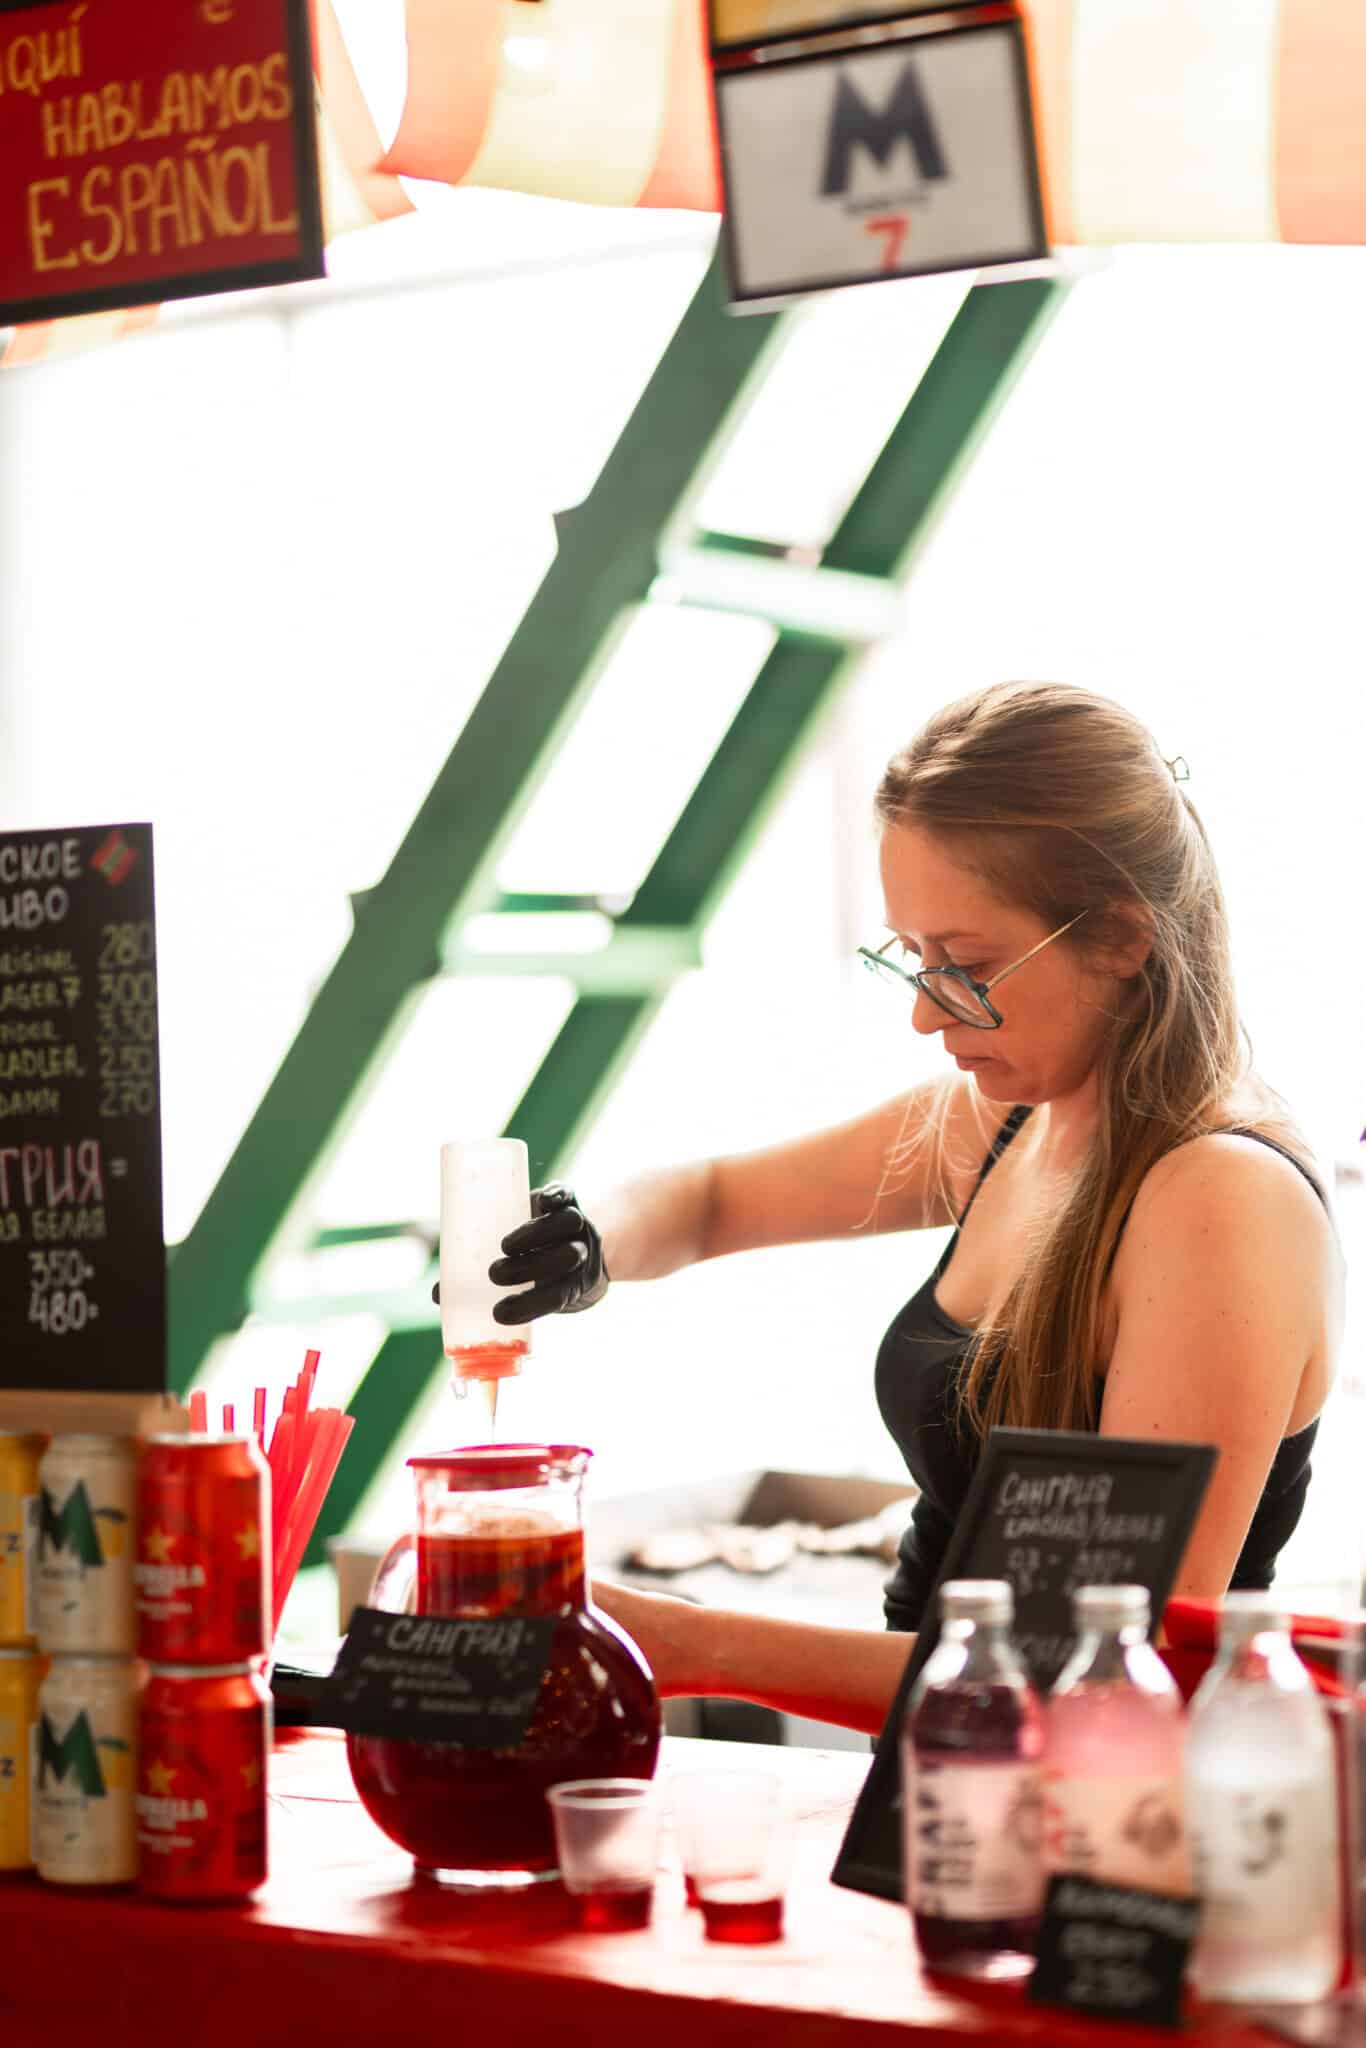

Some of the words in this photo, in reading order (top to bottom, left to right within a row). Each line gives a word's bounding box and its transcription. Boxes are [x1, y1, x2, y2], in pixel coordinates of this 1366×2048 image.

[0, 3, 88, 96] QUÍ
[42, 52, 292, 158] HABLAMOS
[819, 52, 949, 197] M
[28, 135, 297, 272] ESPAÑOL
[866, 214, 909, 273] 7
[0, 838, 82, 884] СКОЕ
[0, 884, 70, 930] ИВО
[0, 1138, 104, 1208] ГРИЯ
